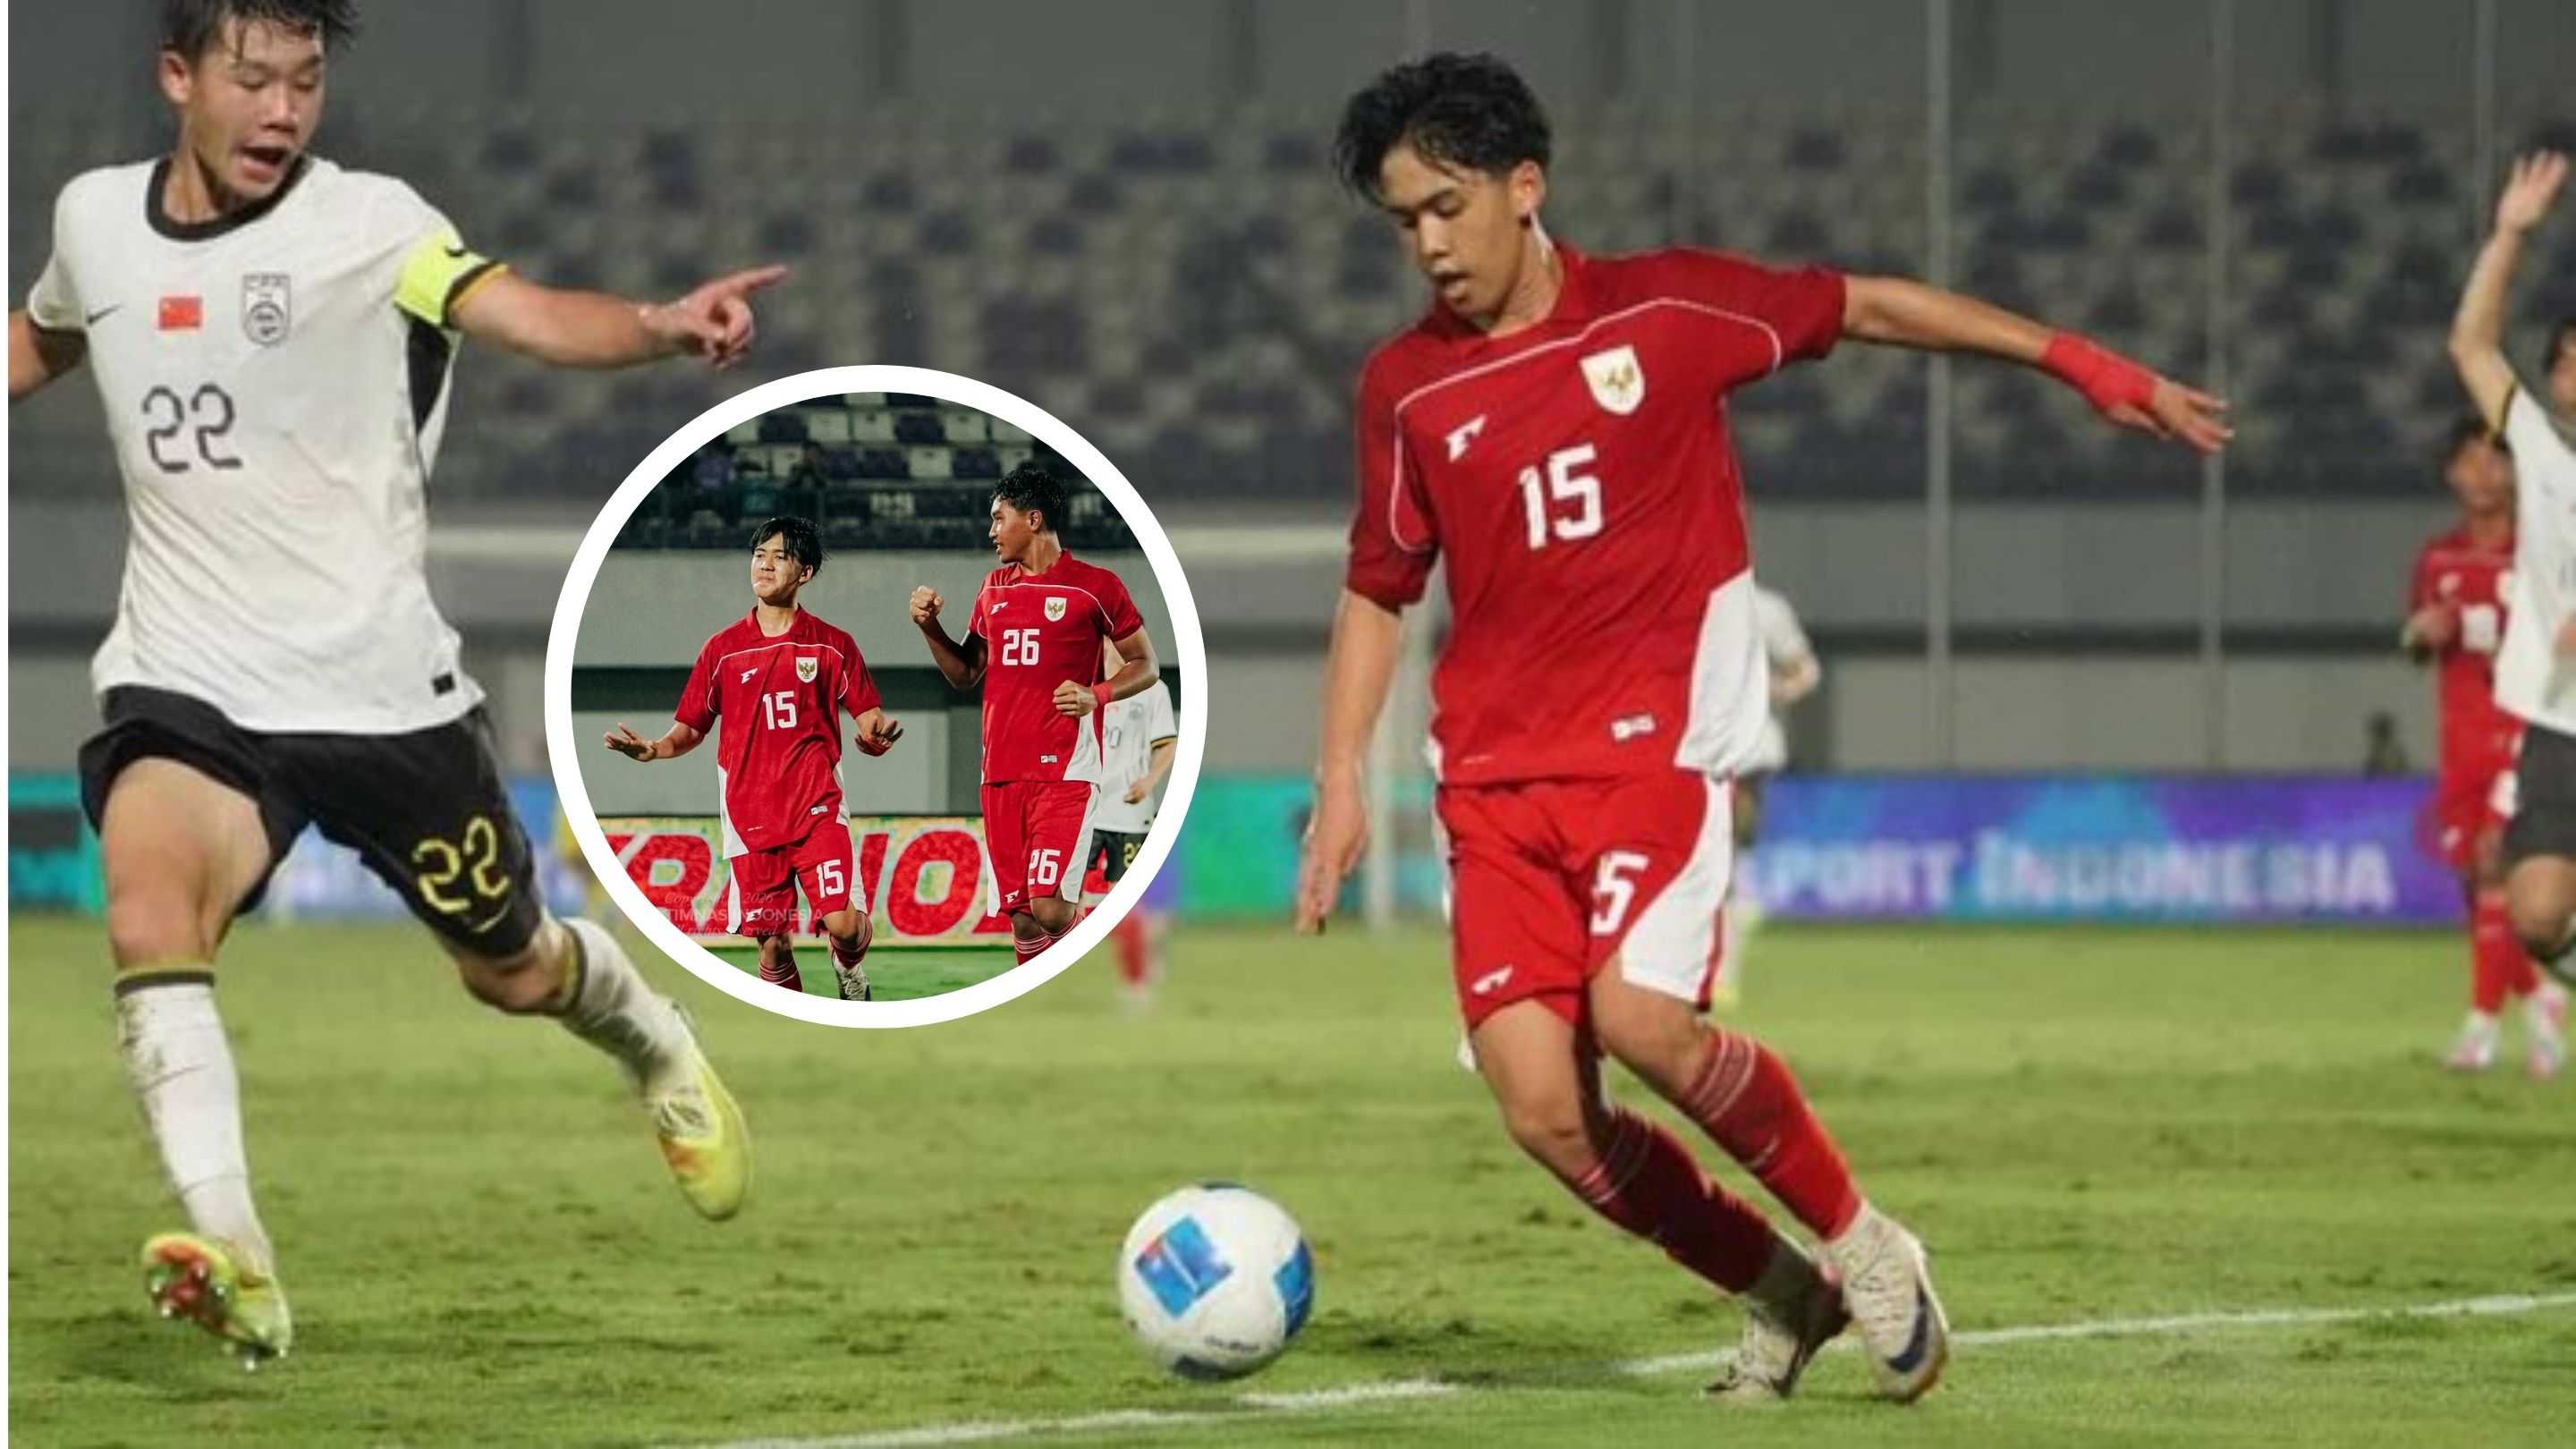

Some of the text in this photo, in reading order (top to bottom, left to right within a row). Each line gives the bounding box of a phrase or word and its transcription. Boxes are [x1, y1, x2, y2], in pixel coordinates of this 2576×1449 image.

[141, 382, 244, 475] 22
[1519, 442, 1603, 550] 15
[1002, 628, 1040, 666] 26
[762, 690, 798, 731] 15
[411, 817, 512, 912] 22
[816, 859, 844, 899] 15
[1028, 848, 1061, 886] 26
[1589, 850, 1650, 936] 5
